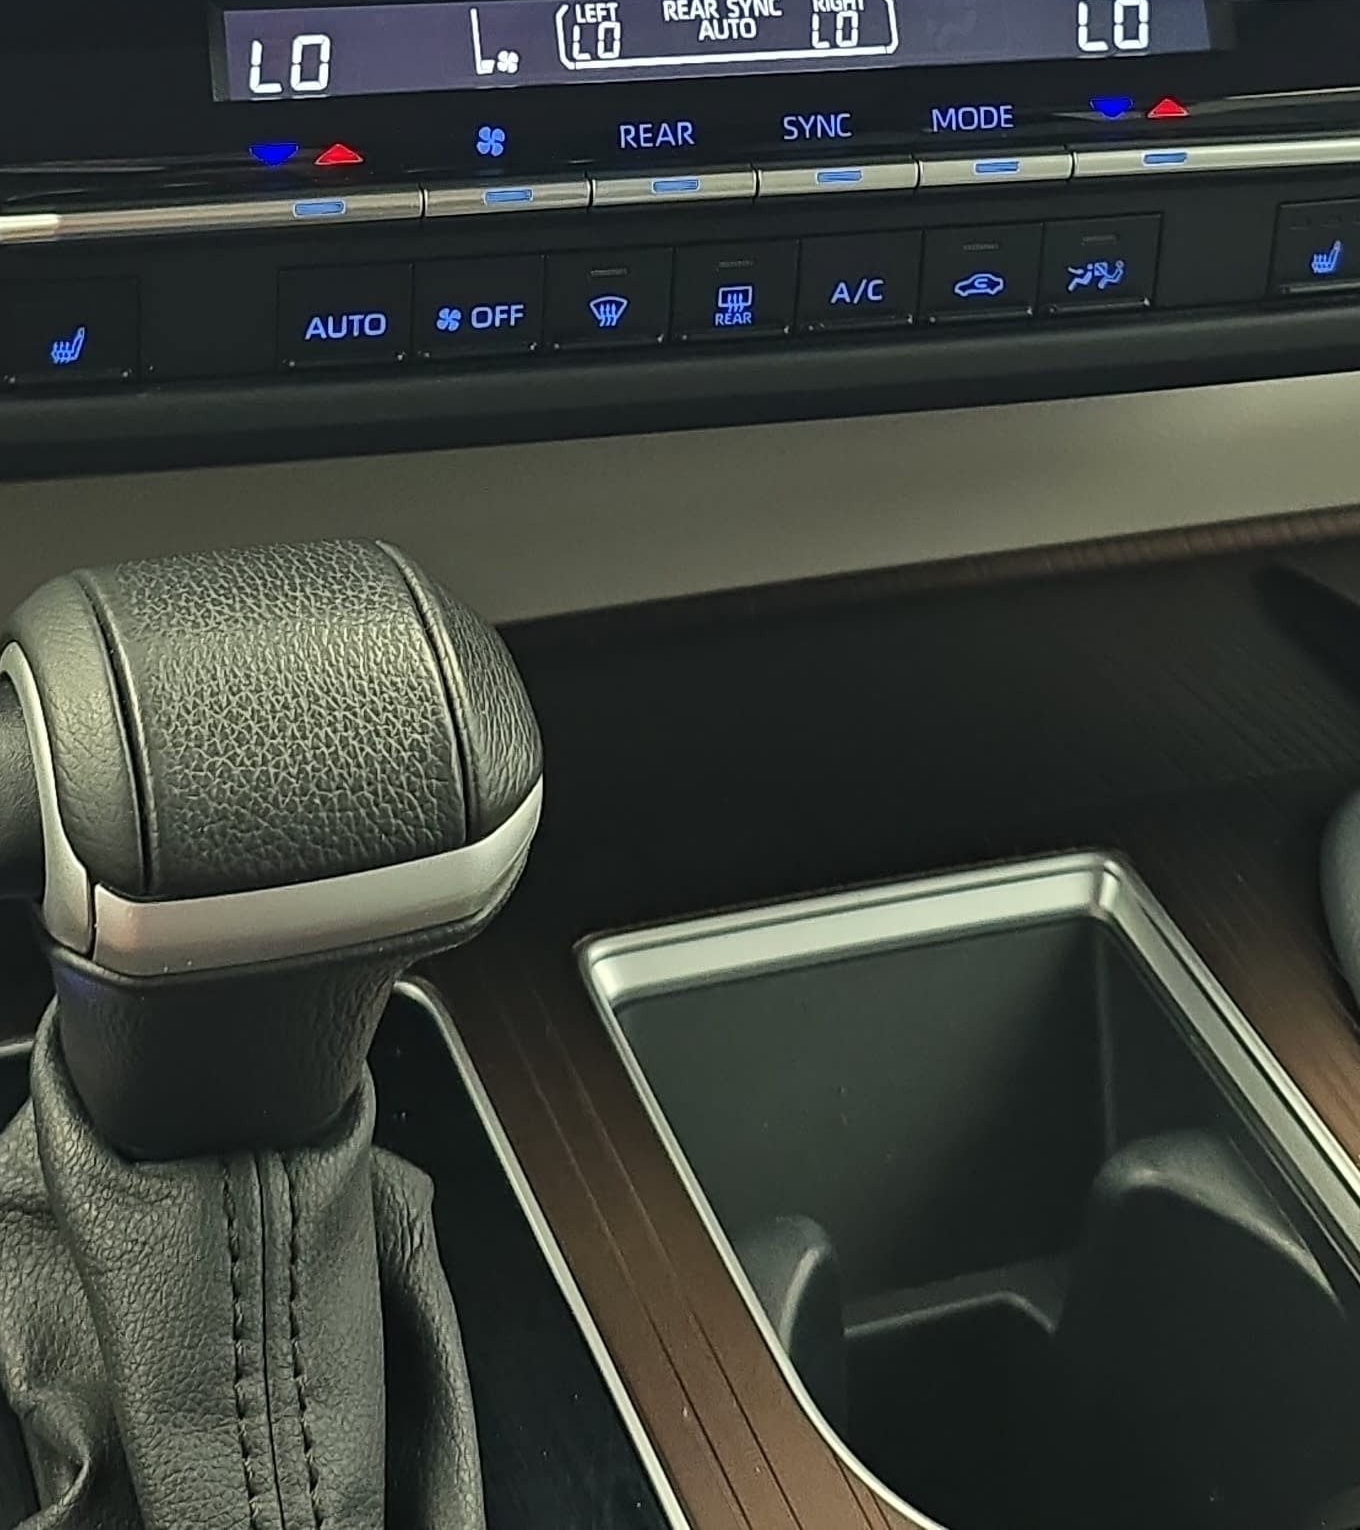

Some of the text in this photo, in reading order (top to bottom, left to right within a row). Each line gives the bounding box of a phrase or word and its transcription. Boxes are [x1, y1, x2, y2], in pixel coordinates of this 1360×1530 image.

[575, 3, 618, 23] LEFT
[663, 0, 720, 20] REAR
[572, 22, 621, 60] LO
[699, 18, 757, 41] AUTO
[812, 11, 859, 48] LO
[249, 34, 331, 95] LO
[782, 112, 854, 140] SYNC
[931, 105, 1015, 132] MODE
[619, 121, 695, 149] REAR
[830, 278, 884, 304] A/C
[305, 313, 387, 340] AUTO
[470, 303, 526, 330] OFF
[714, 311, 752, 326] REAR
